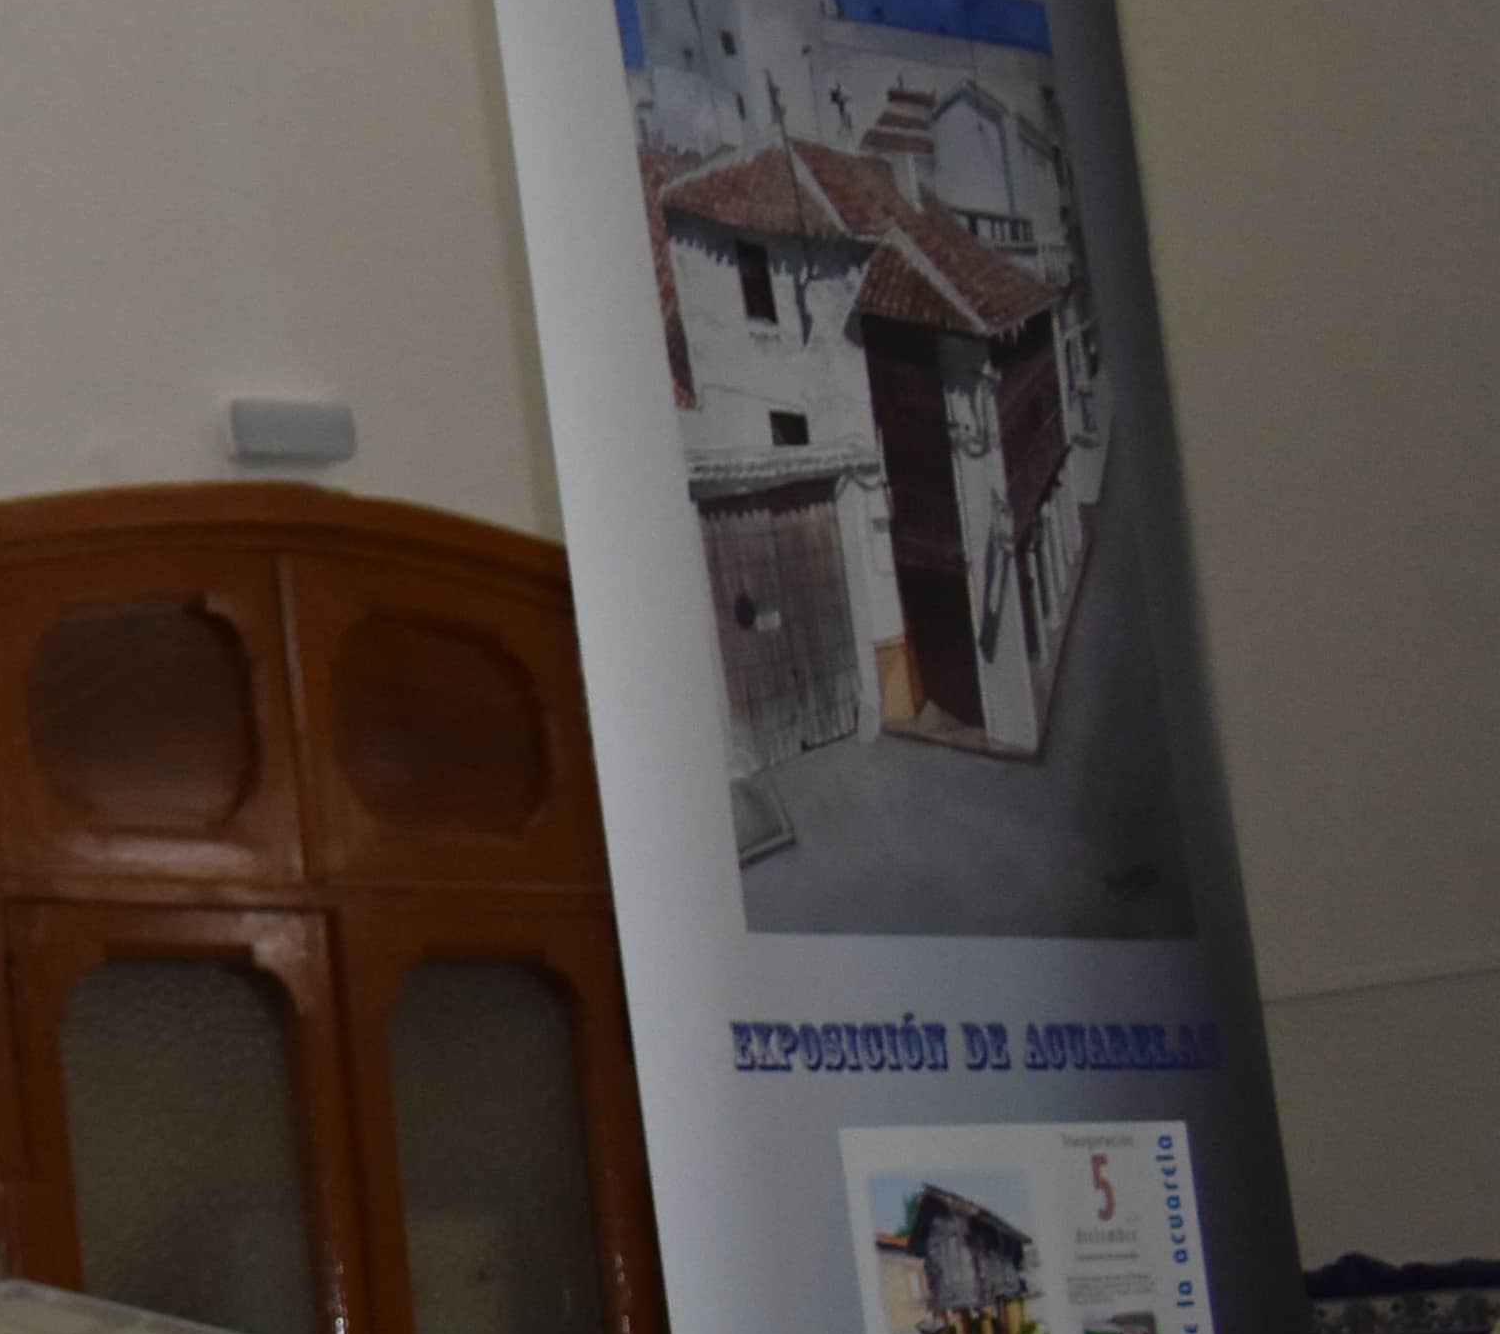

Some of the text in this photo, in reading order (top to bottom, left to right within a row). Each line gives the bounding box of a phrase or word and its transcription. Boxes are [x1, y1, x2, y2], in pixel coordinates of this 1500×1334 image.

[729, 1011, 949, 1071] EXPOSICIÓN
[960, 1022, 1011, 1070] DE
[1091, 1152, 1116, 1221] 5
[1155, 1133, 1190, 1264] acuarela
[1176, 1279, 1195, 1308] la
